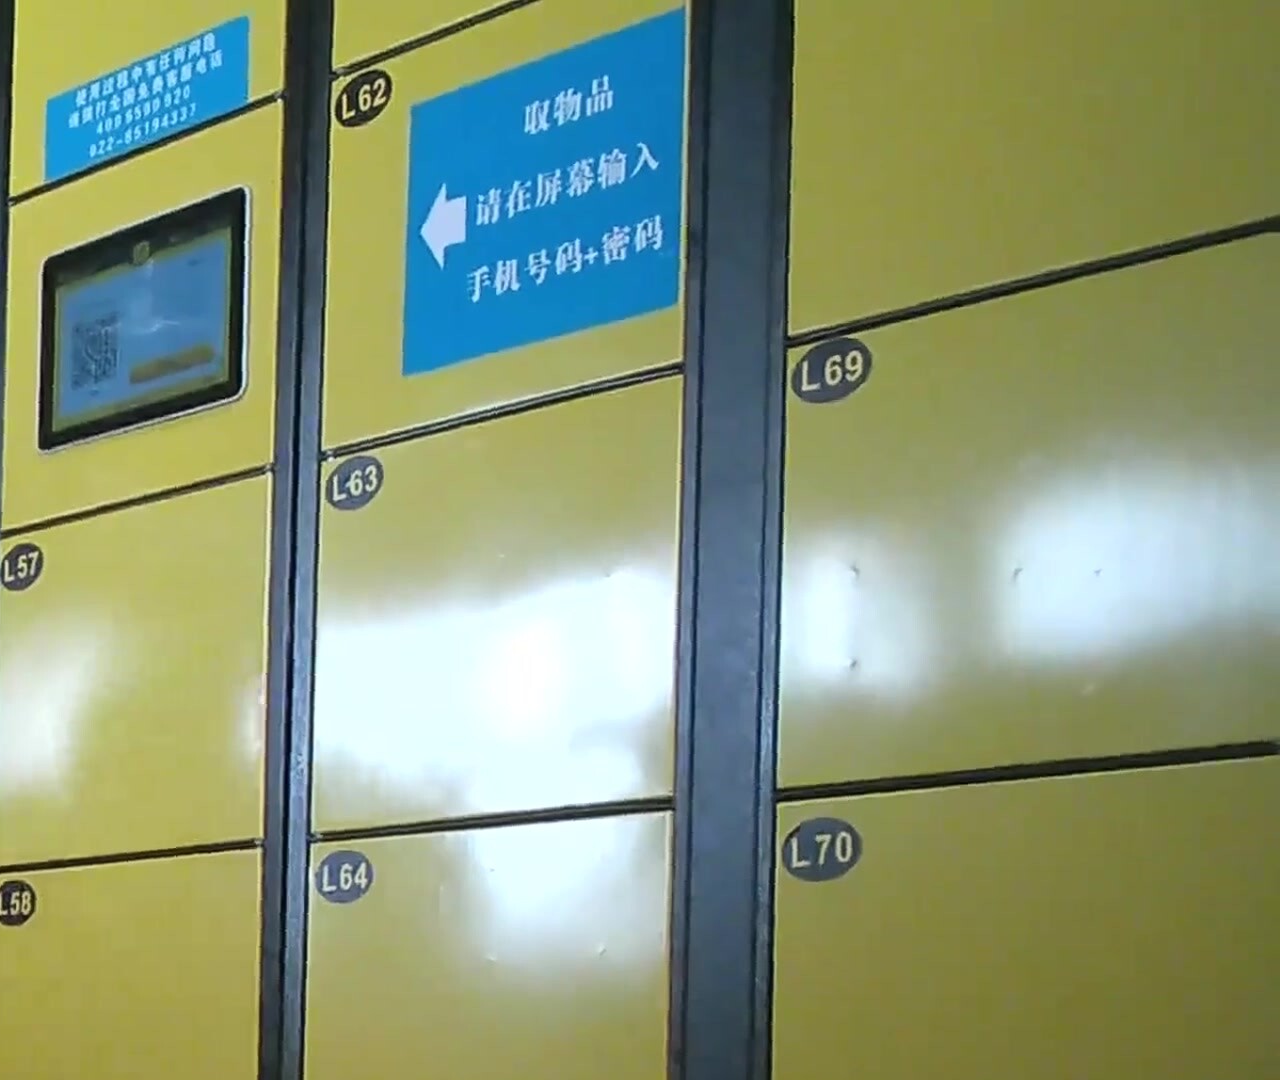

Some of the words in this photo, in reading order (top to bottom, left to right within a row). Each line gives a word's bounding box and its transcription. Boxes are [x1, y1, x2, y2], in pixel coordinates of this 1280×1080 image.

[342, 77, 387, 120] L62
[523, 75, 614, 135] 取物品
[475, 142, 660, 227] 请在屏幕输入
[466, 214, 664, 303] 手机号码+密码
[801, 350, 864, 392] L69
[332, 465, 379, 502] L63
[4, 551, 39, 582] L57
[790, 831, 853, 868] L70
[322, 861, 368, 893] L64
